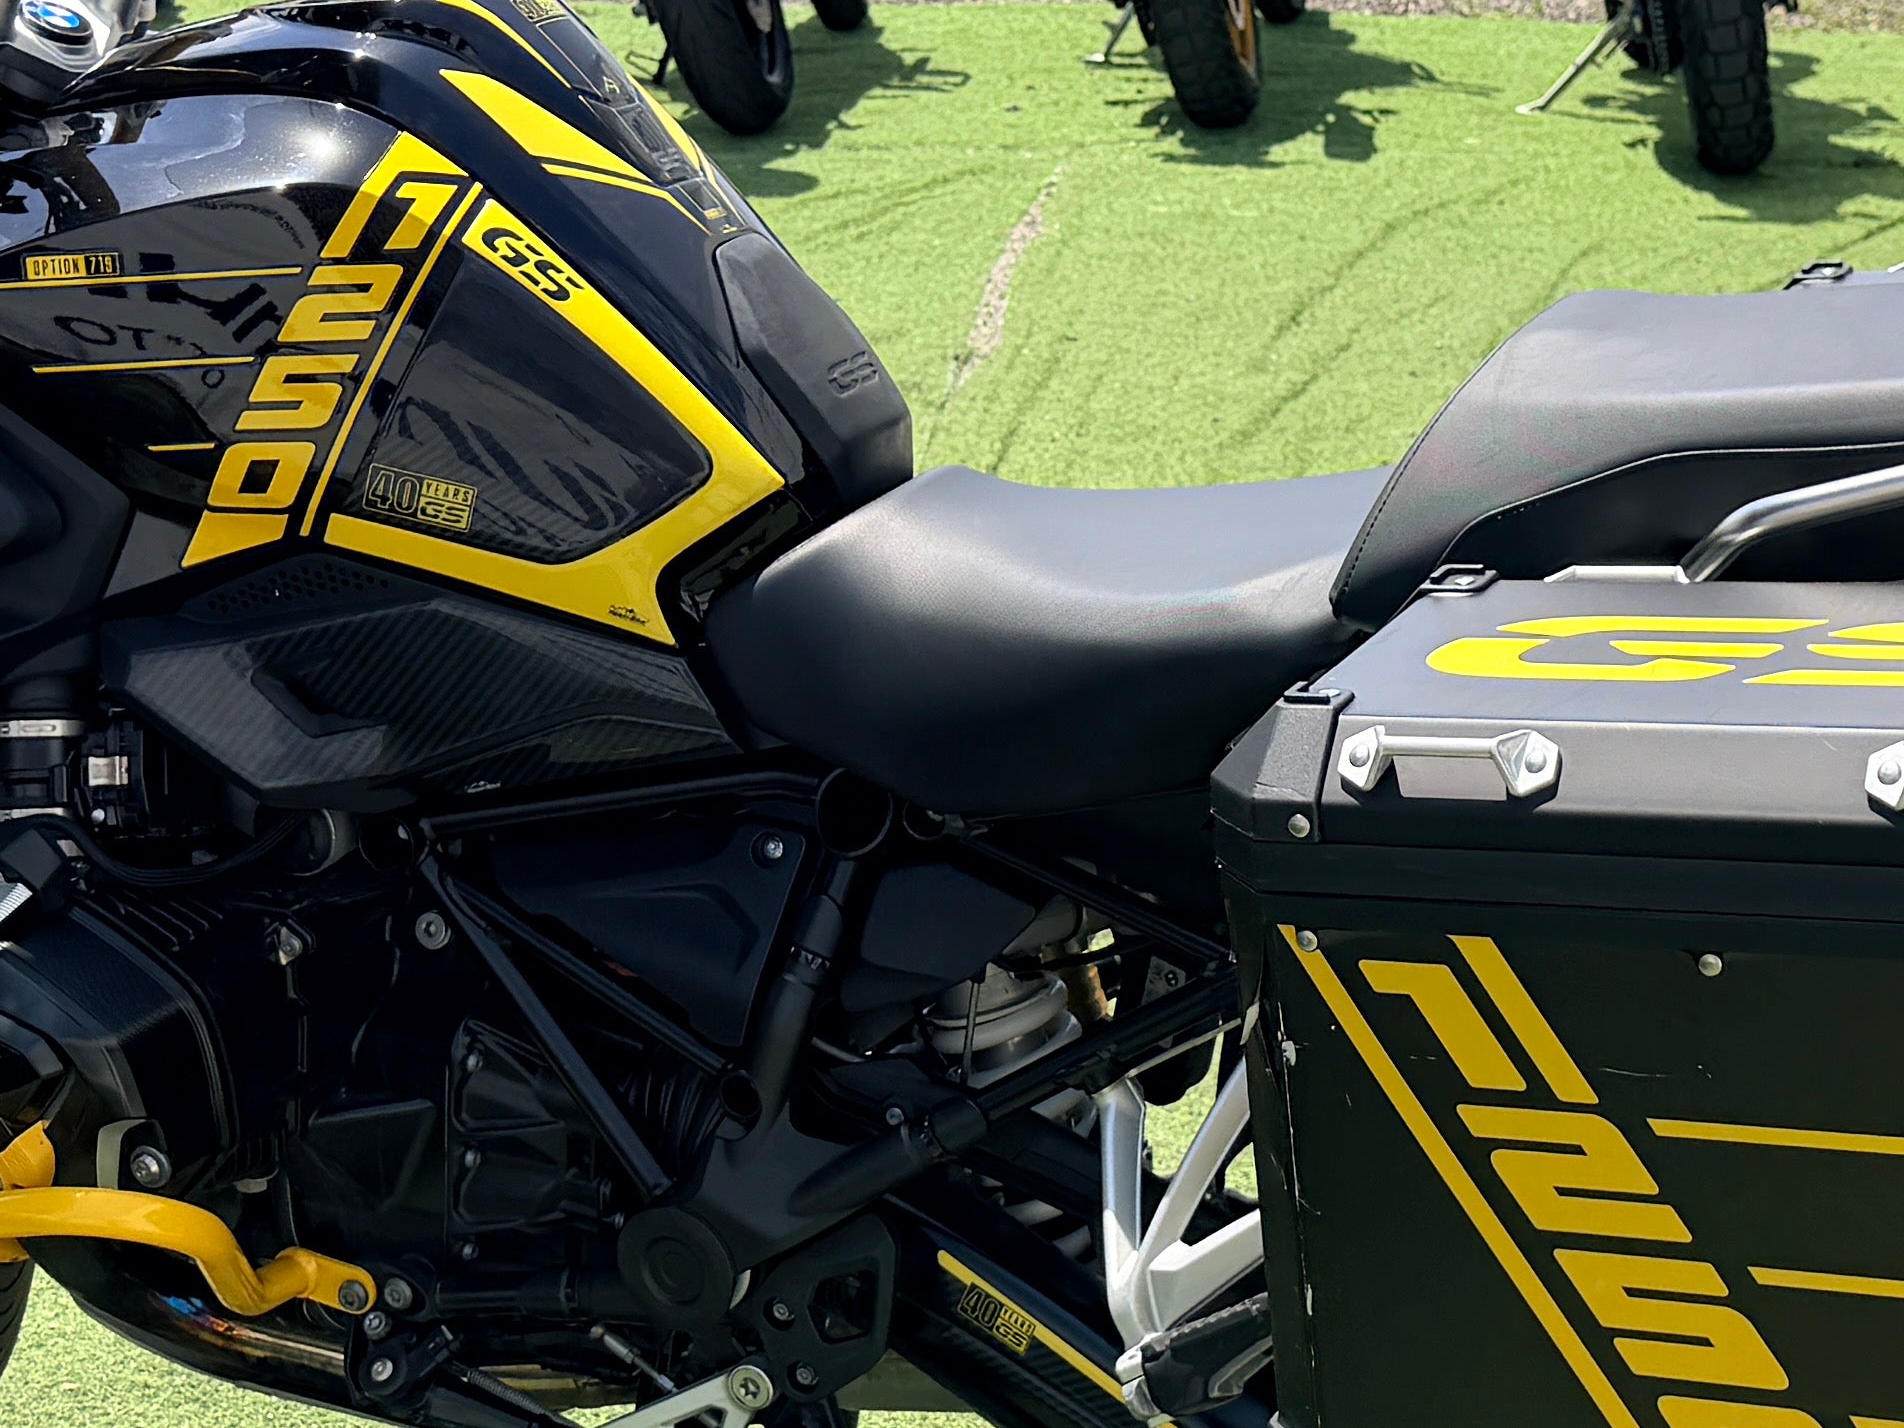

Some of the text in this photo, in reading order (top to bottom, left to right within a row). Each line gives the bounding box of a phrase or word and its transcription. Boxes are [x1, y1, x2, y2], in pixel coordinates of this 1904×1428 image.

[33, 255, 113, 277] OPTION 719
[481, 227, 585, 302] GS
[206, 181, 459, 509] 1250
[369, 470, 470, 514] 40 YEARS
[420, 500, 467, 524] GS
[963, 1288, 1000, 1327] 40
[996, 1322, 1027, 1348] GS
